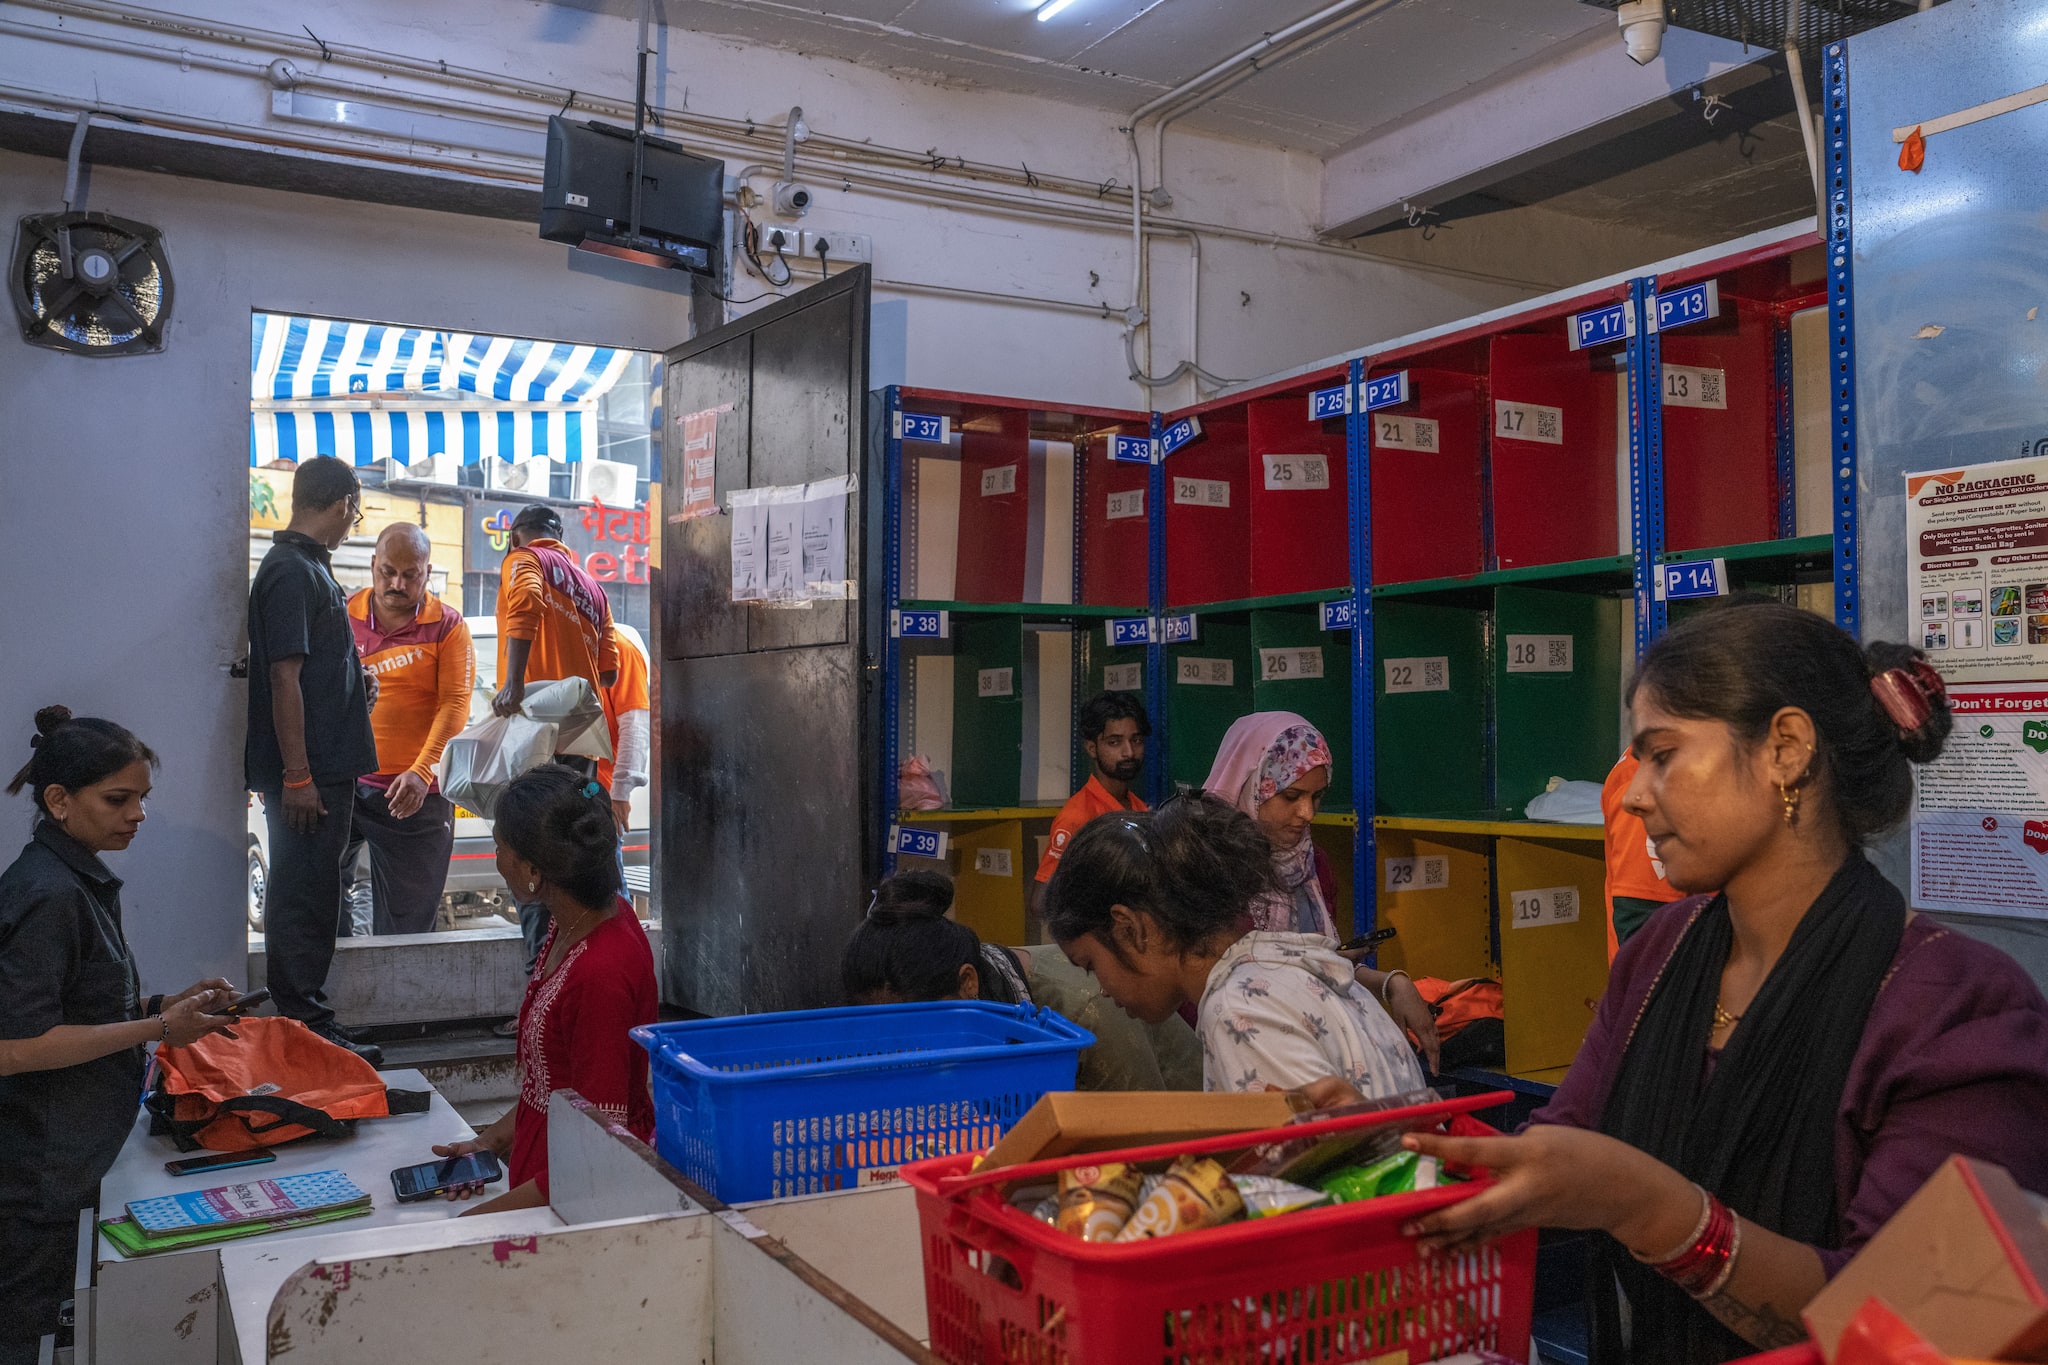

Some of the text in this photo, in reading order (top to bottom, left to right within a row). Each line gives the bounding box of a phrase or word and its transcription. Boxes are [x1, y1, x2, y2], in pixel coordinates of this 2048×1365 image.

[1660, 294, 1704, 322] P 13
[1581, 312, 1621, 340] P 17
[1369, 380, 1398, 402] P 21
[1667, 374, 1688, 398] 13
[1317, 393, 1343, 413] P 25
[904, 419, 938, 436] P 37
[1503, 410, 1524, 431] 17
[1162, 423, 1190, 450] P 29
[1382, 423, 1403, 442] 21
[1118, 441, 1148, 458] P 33
[1272, 464, 1293, 481] 25
[986, 476, 996, 489] 37
[1180, 484, 1196, 498] 29
[1936, 474, 2035, 495] NO PACKAGING
[1110, 500, 1122, 512] 33
[1953, 493, 1982, 502] Quantity
[1937, 515, 1965, 523] packaging
[1975, 542, 1997, 550] Small
[1668, 568, 1714, 592] P 14
[1326, 606, 1349, 624] P 26
[902, 616, 937, 632] P 38
[1116, 624, 1146, 640] P 34
[1167, 621, 1189, 638] P 30
[1514, 644, 1536, 664] 18
[1184, 664, 1200, 677] 30
[1267, 656, 1288, 673] 26
[982, 676, 992, 690] 38
[1108, 672, 1118, 685] 34
[1391, 666, 1412, 686] 22
[1952, 698, 2048, 710] Don't Forget
[900, 833, 936, 852] P 39
[980, 854, 990, 868] 39
[1392, 865, 1412, 885] 23
[1519, 898, 1541, 920] 19
